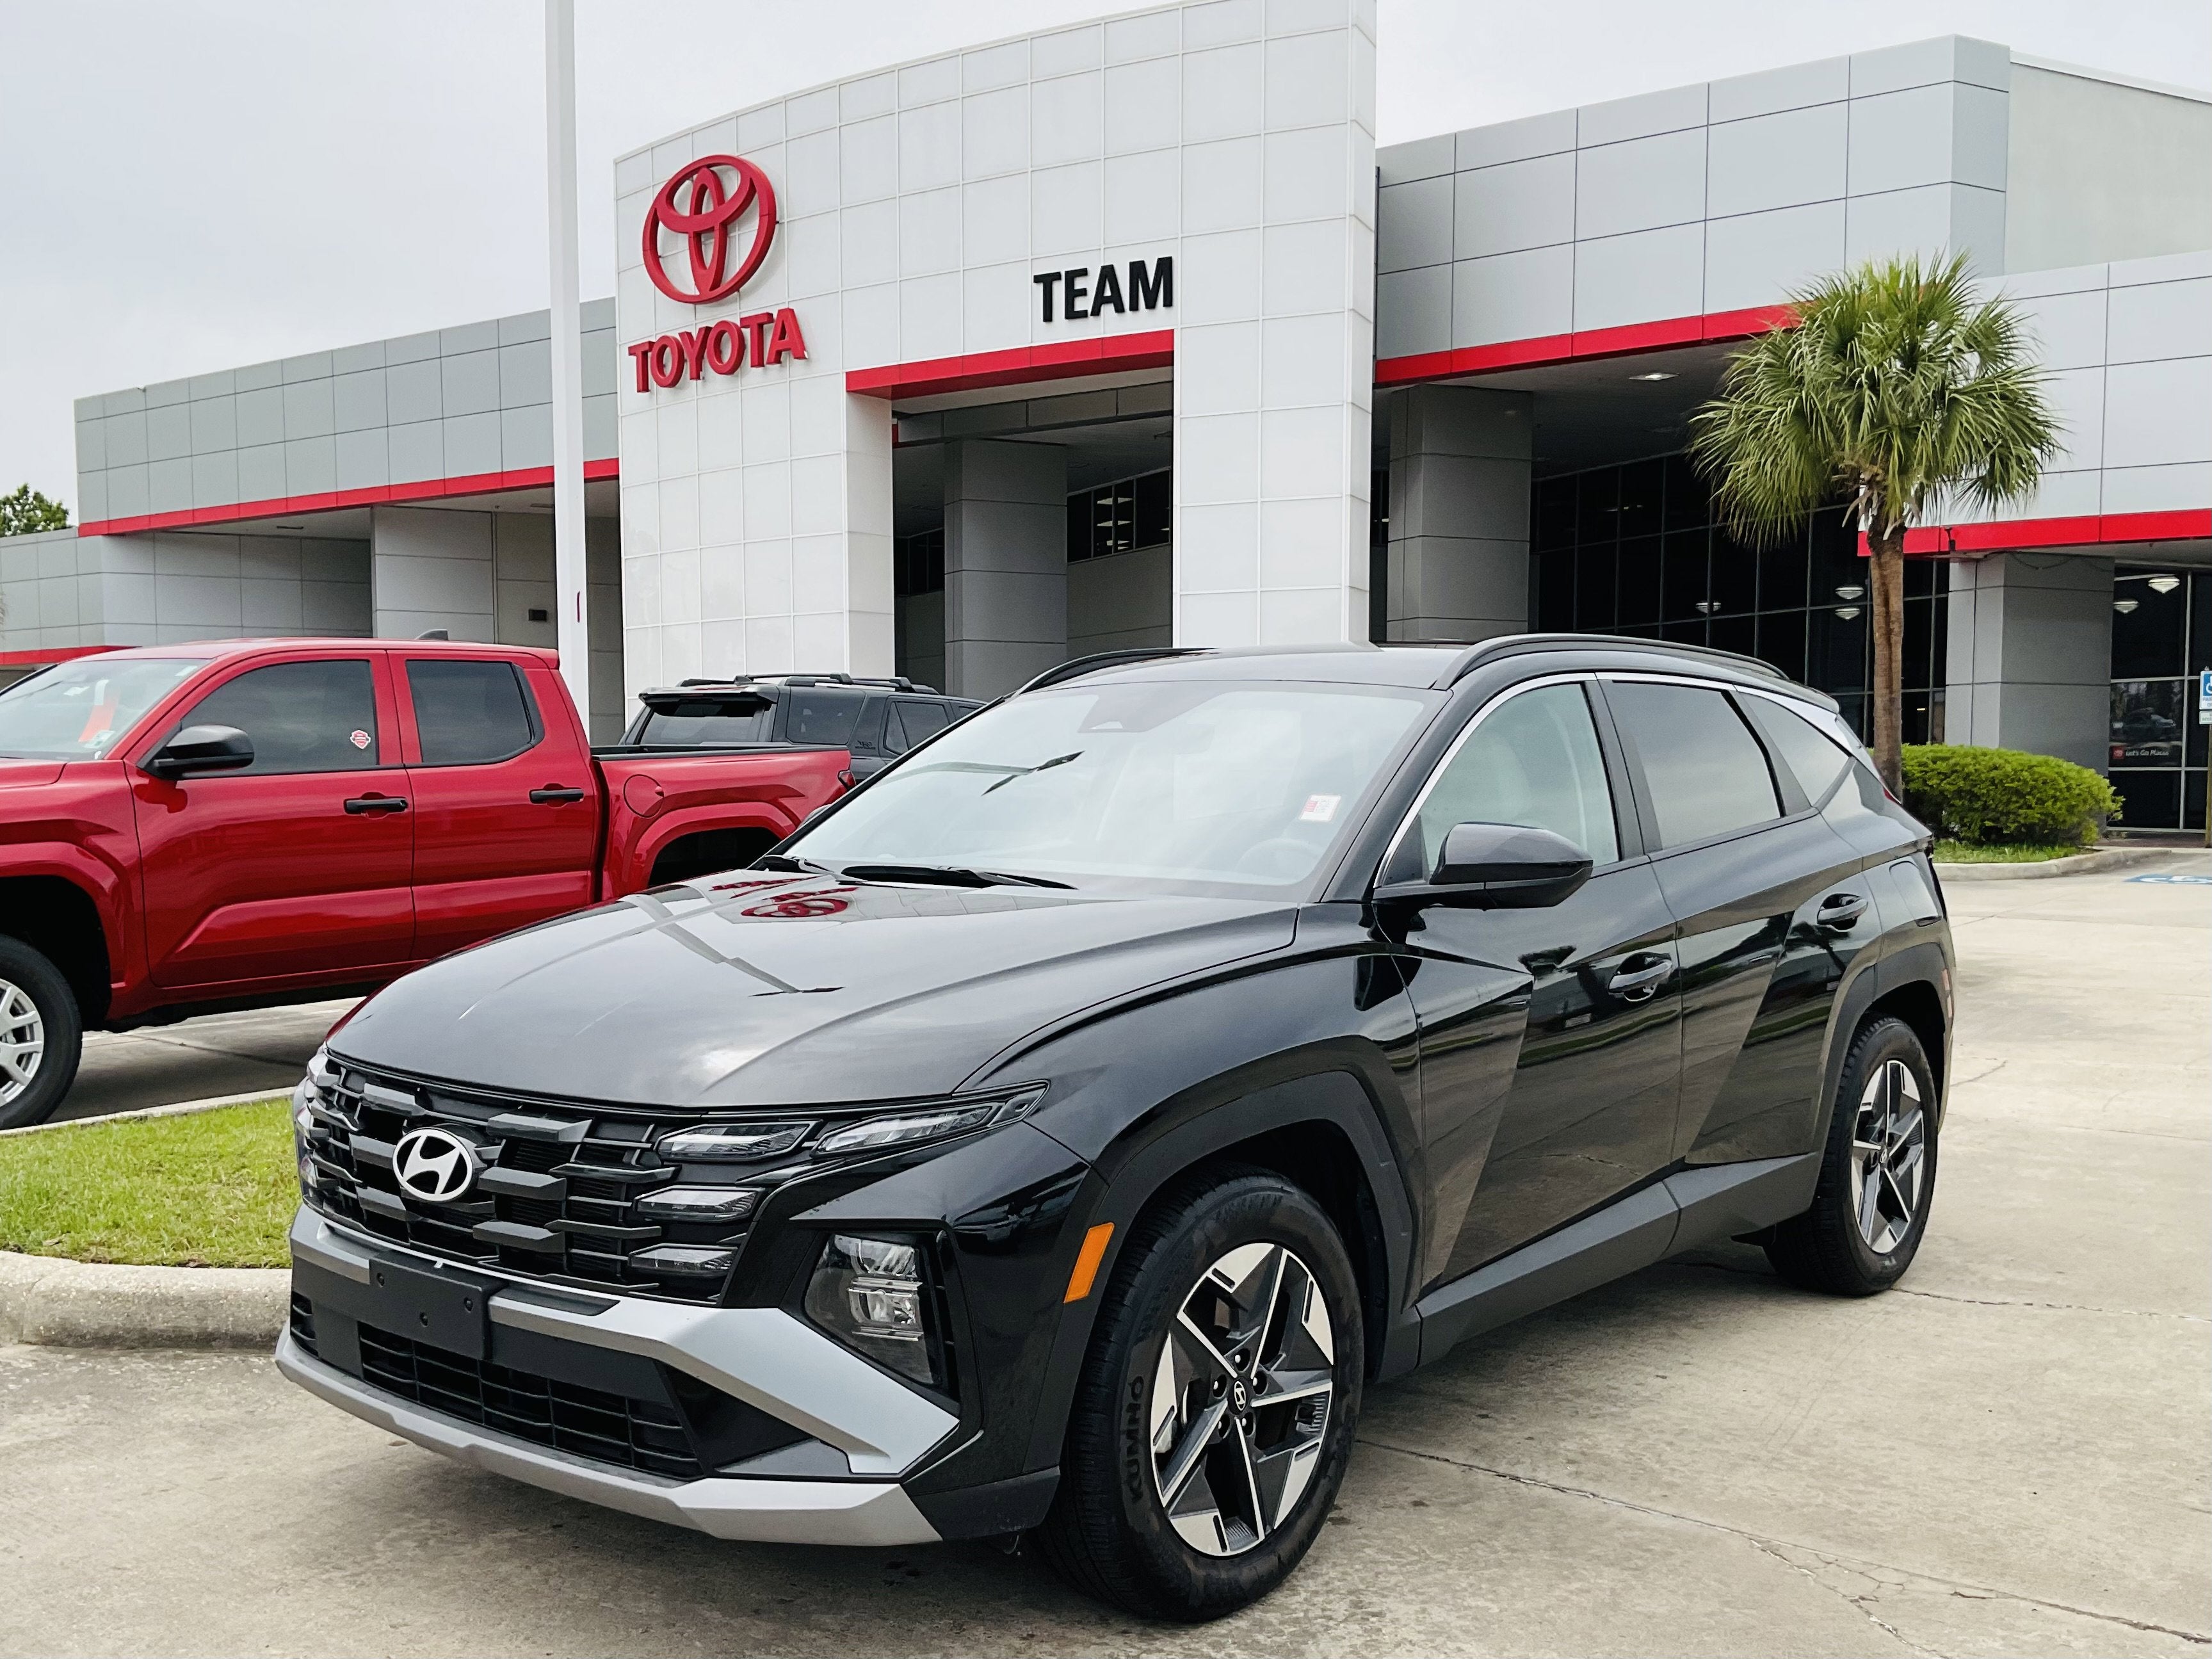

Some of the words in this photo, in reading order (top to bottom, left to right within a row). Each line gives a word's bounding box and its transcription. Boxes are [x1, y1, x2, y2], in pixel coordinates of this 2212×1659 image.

[1033, 256, 1173, 322] TEAM
[628, 307, 808, 392] TOYOTA
[1126, 1376, 1145, 1502] KUMHO
